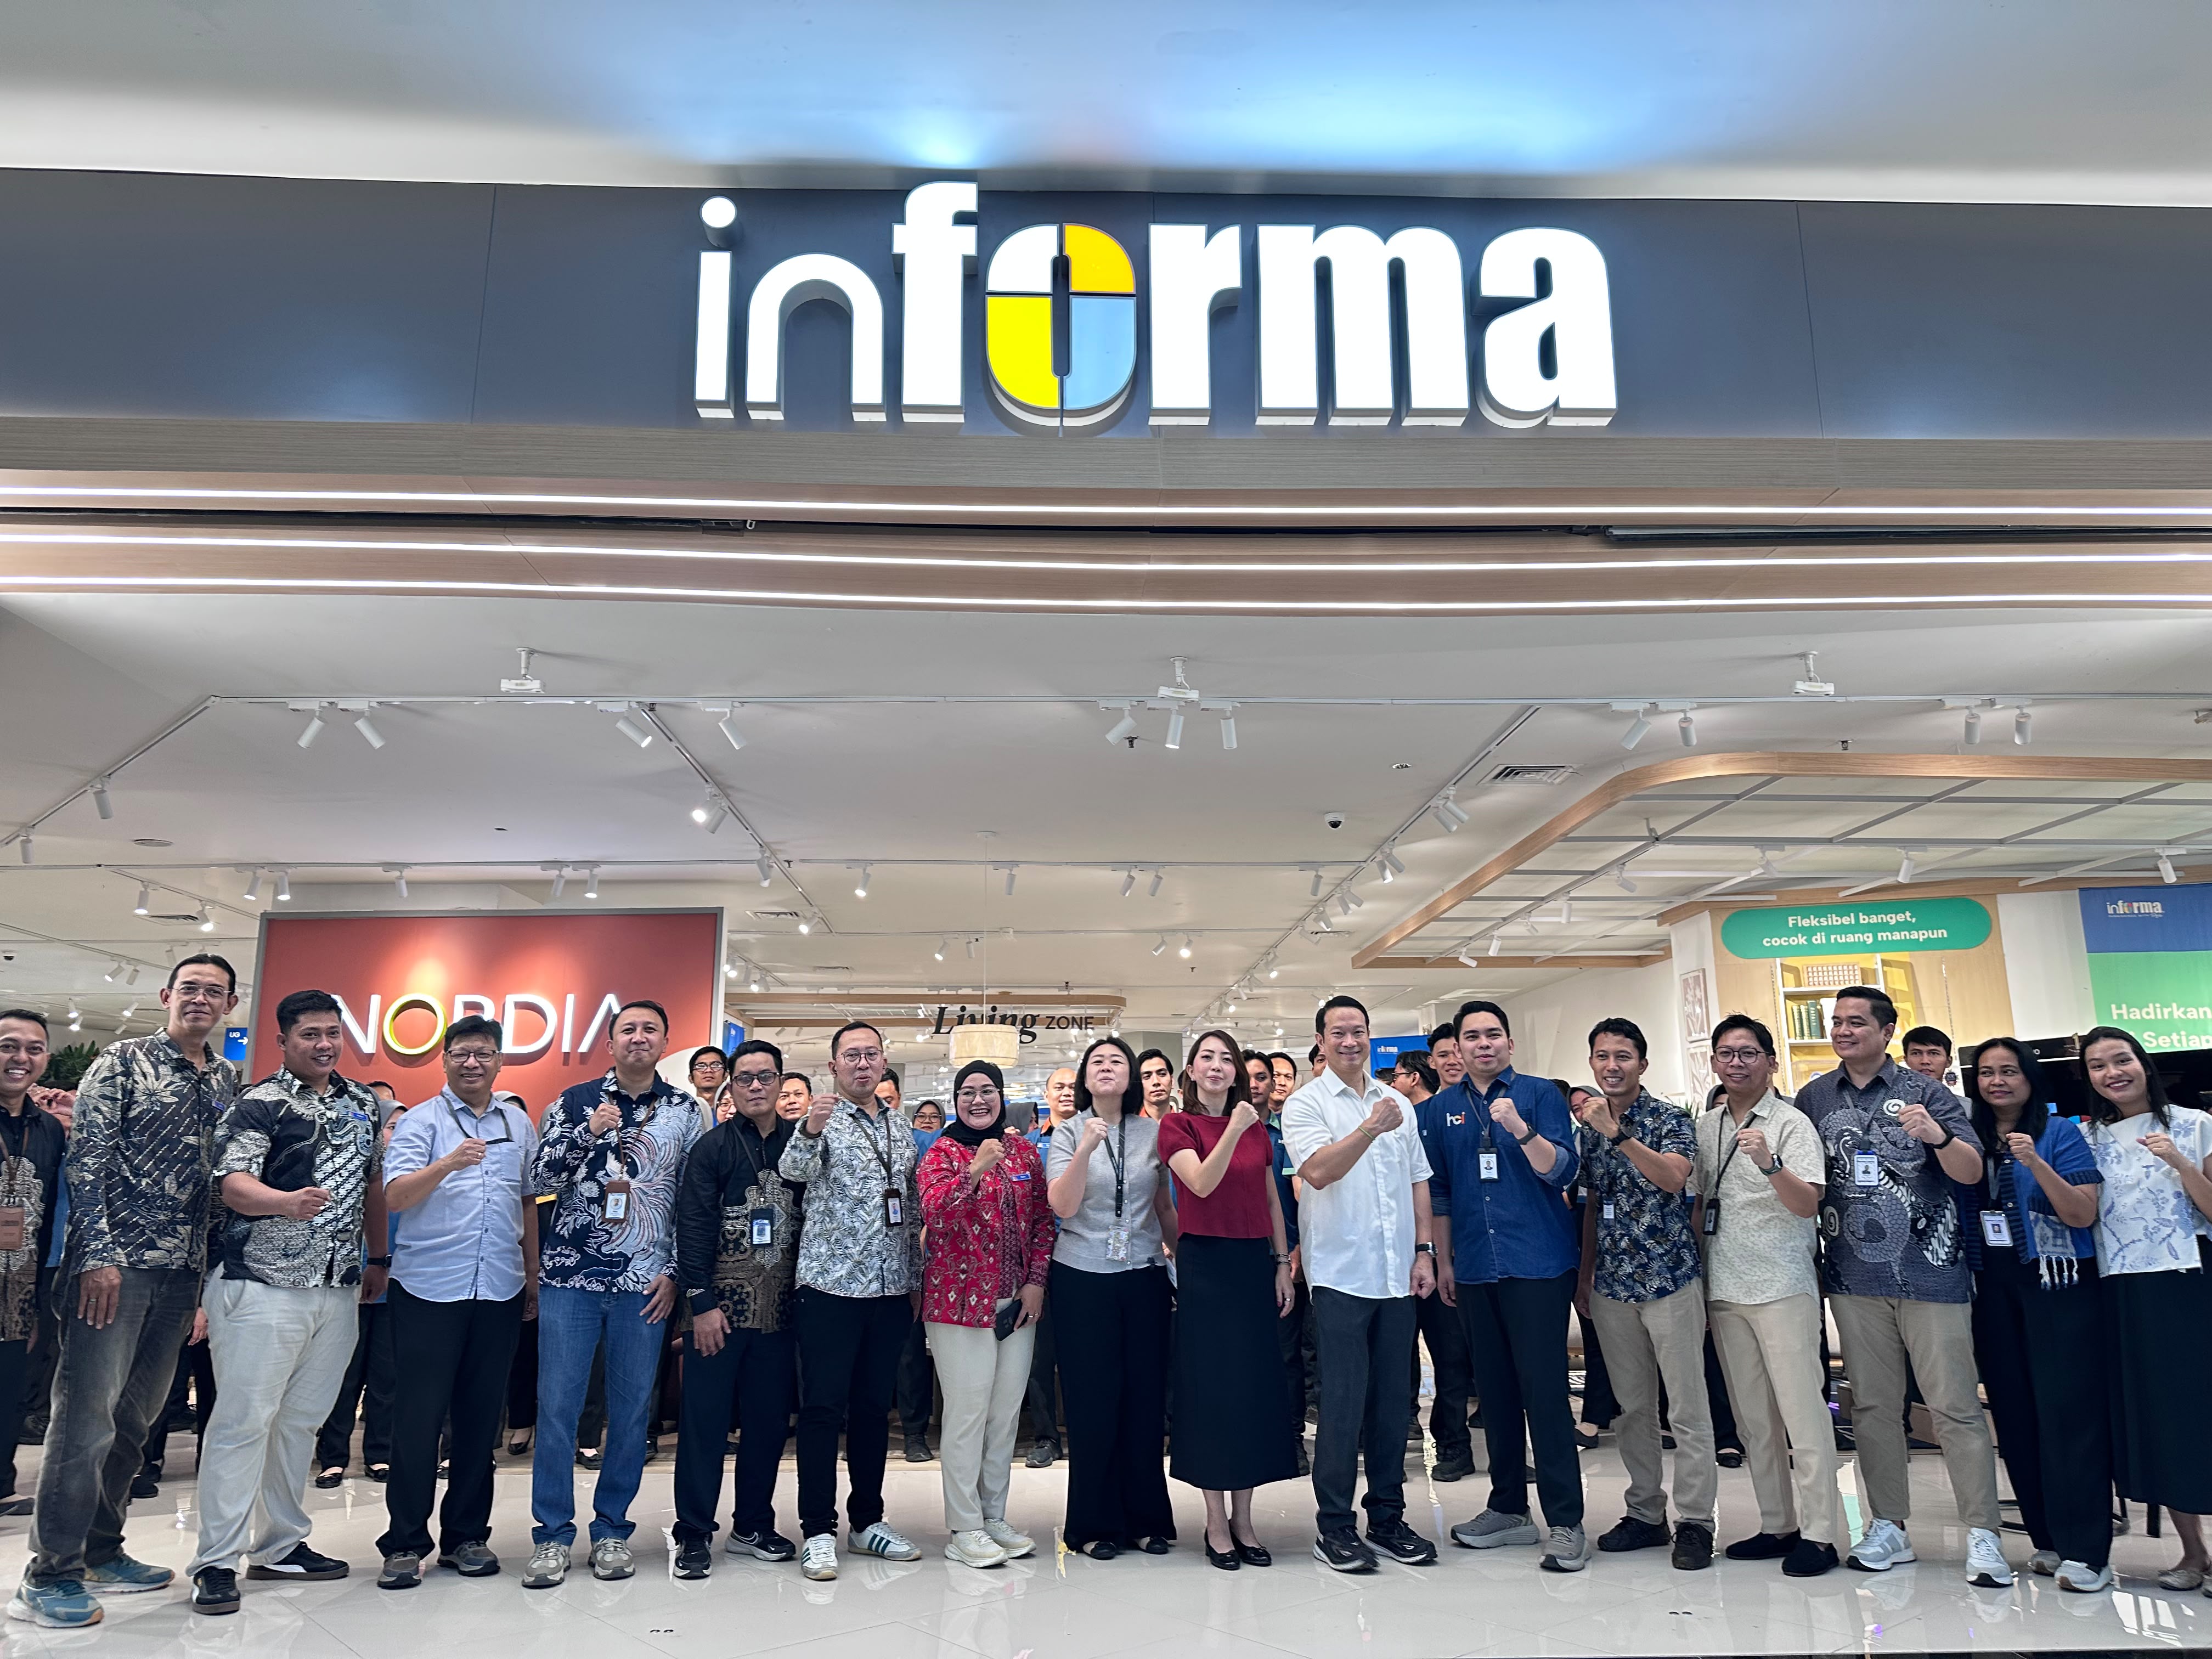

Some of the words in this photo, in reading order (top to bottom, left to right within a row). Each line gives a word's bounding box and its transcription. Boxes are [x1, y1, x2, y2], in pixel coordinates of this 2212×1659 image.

[693, 181, 1618, 425] informa
[2107, 900, 2162, 914] informa
[1788, 912, 1854, 928] Fleksibel
[1859, 911, 1916, 925] banget,
[1763, 933, 1808, 946] cocok
[1812, 932, 1826, 944] di
[1830, 932, 1873, 944] ruang
[1877, 929, 1948, 941] manapun
[2111, 1002, 2212, 1020] Hadirkan
[1045, 1015, 1095, 1030] ZONE
[1446, 1111, 1465, 1126] hci
